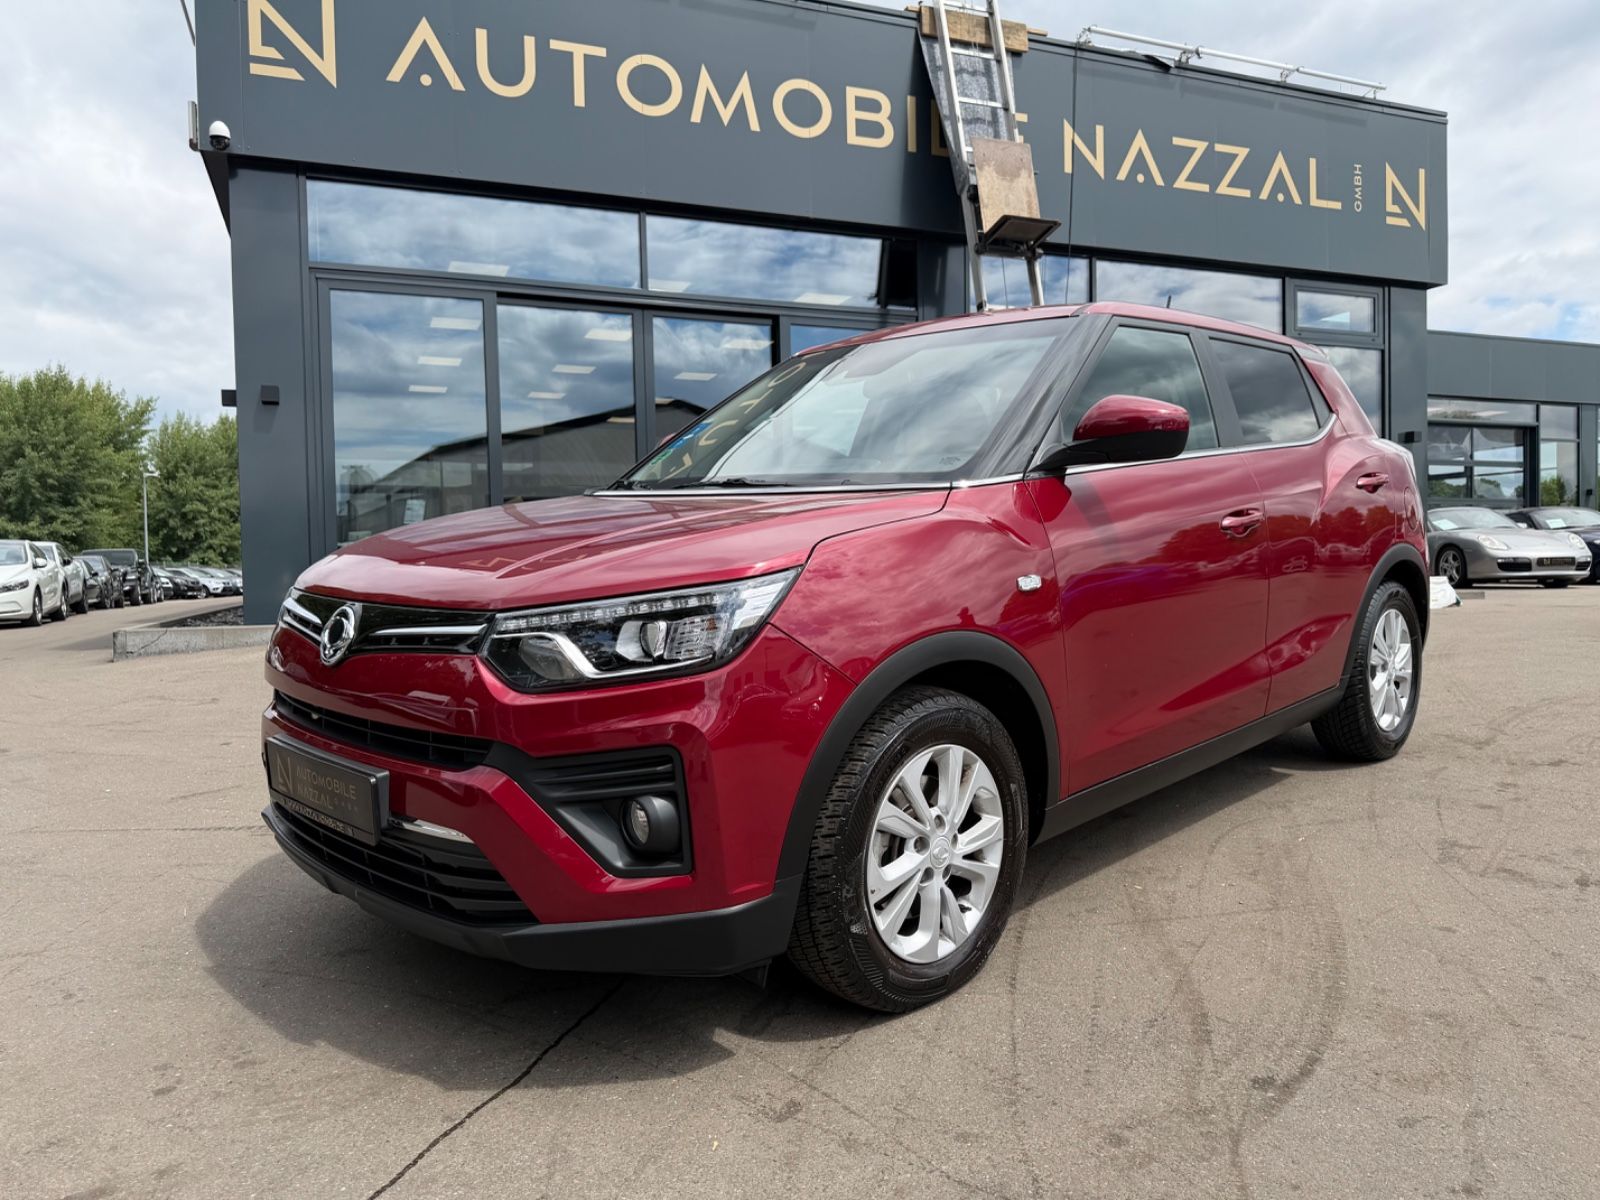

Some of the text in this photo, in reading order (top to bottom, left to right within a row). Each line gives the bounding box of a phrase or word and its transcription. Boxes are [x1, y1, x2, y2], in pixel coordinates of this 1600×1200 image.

[386, 16, 1342, 210] AUTOMOBIL NAZZAL
[1353, 163, 1363, 213] GMBH
[296, 766, 358, 800] AUTOMOBILE
